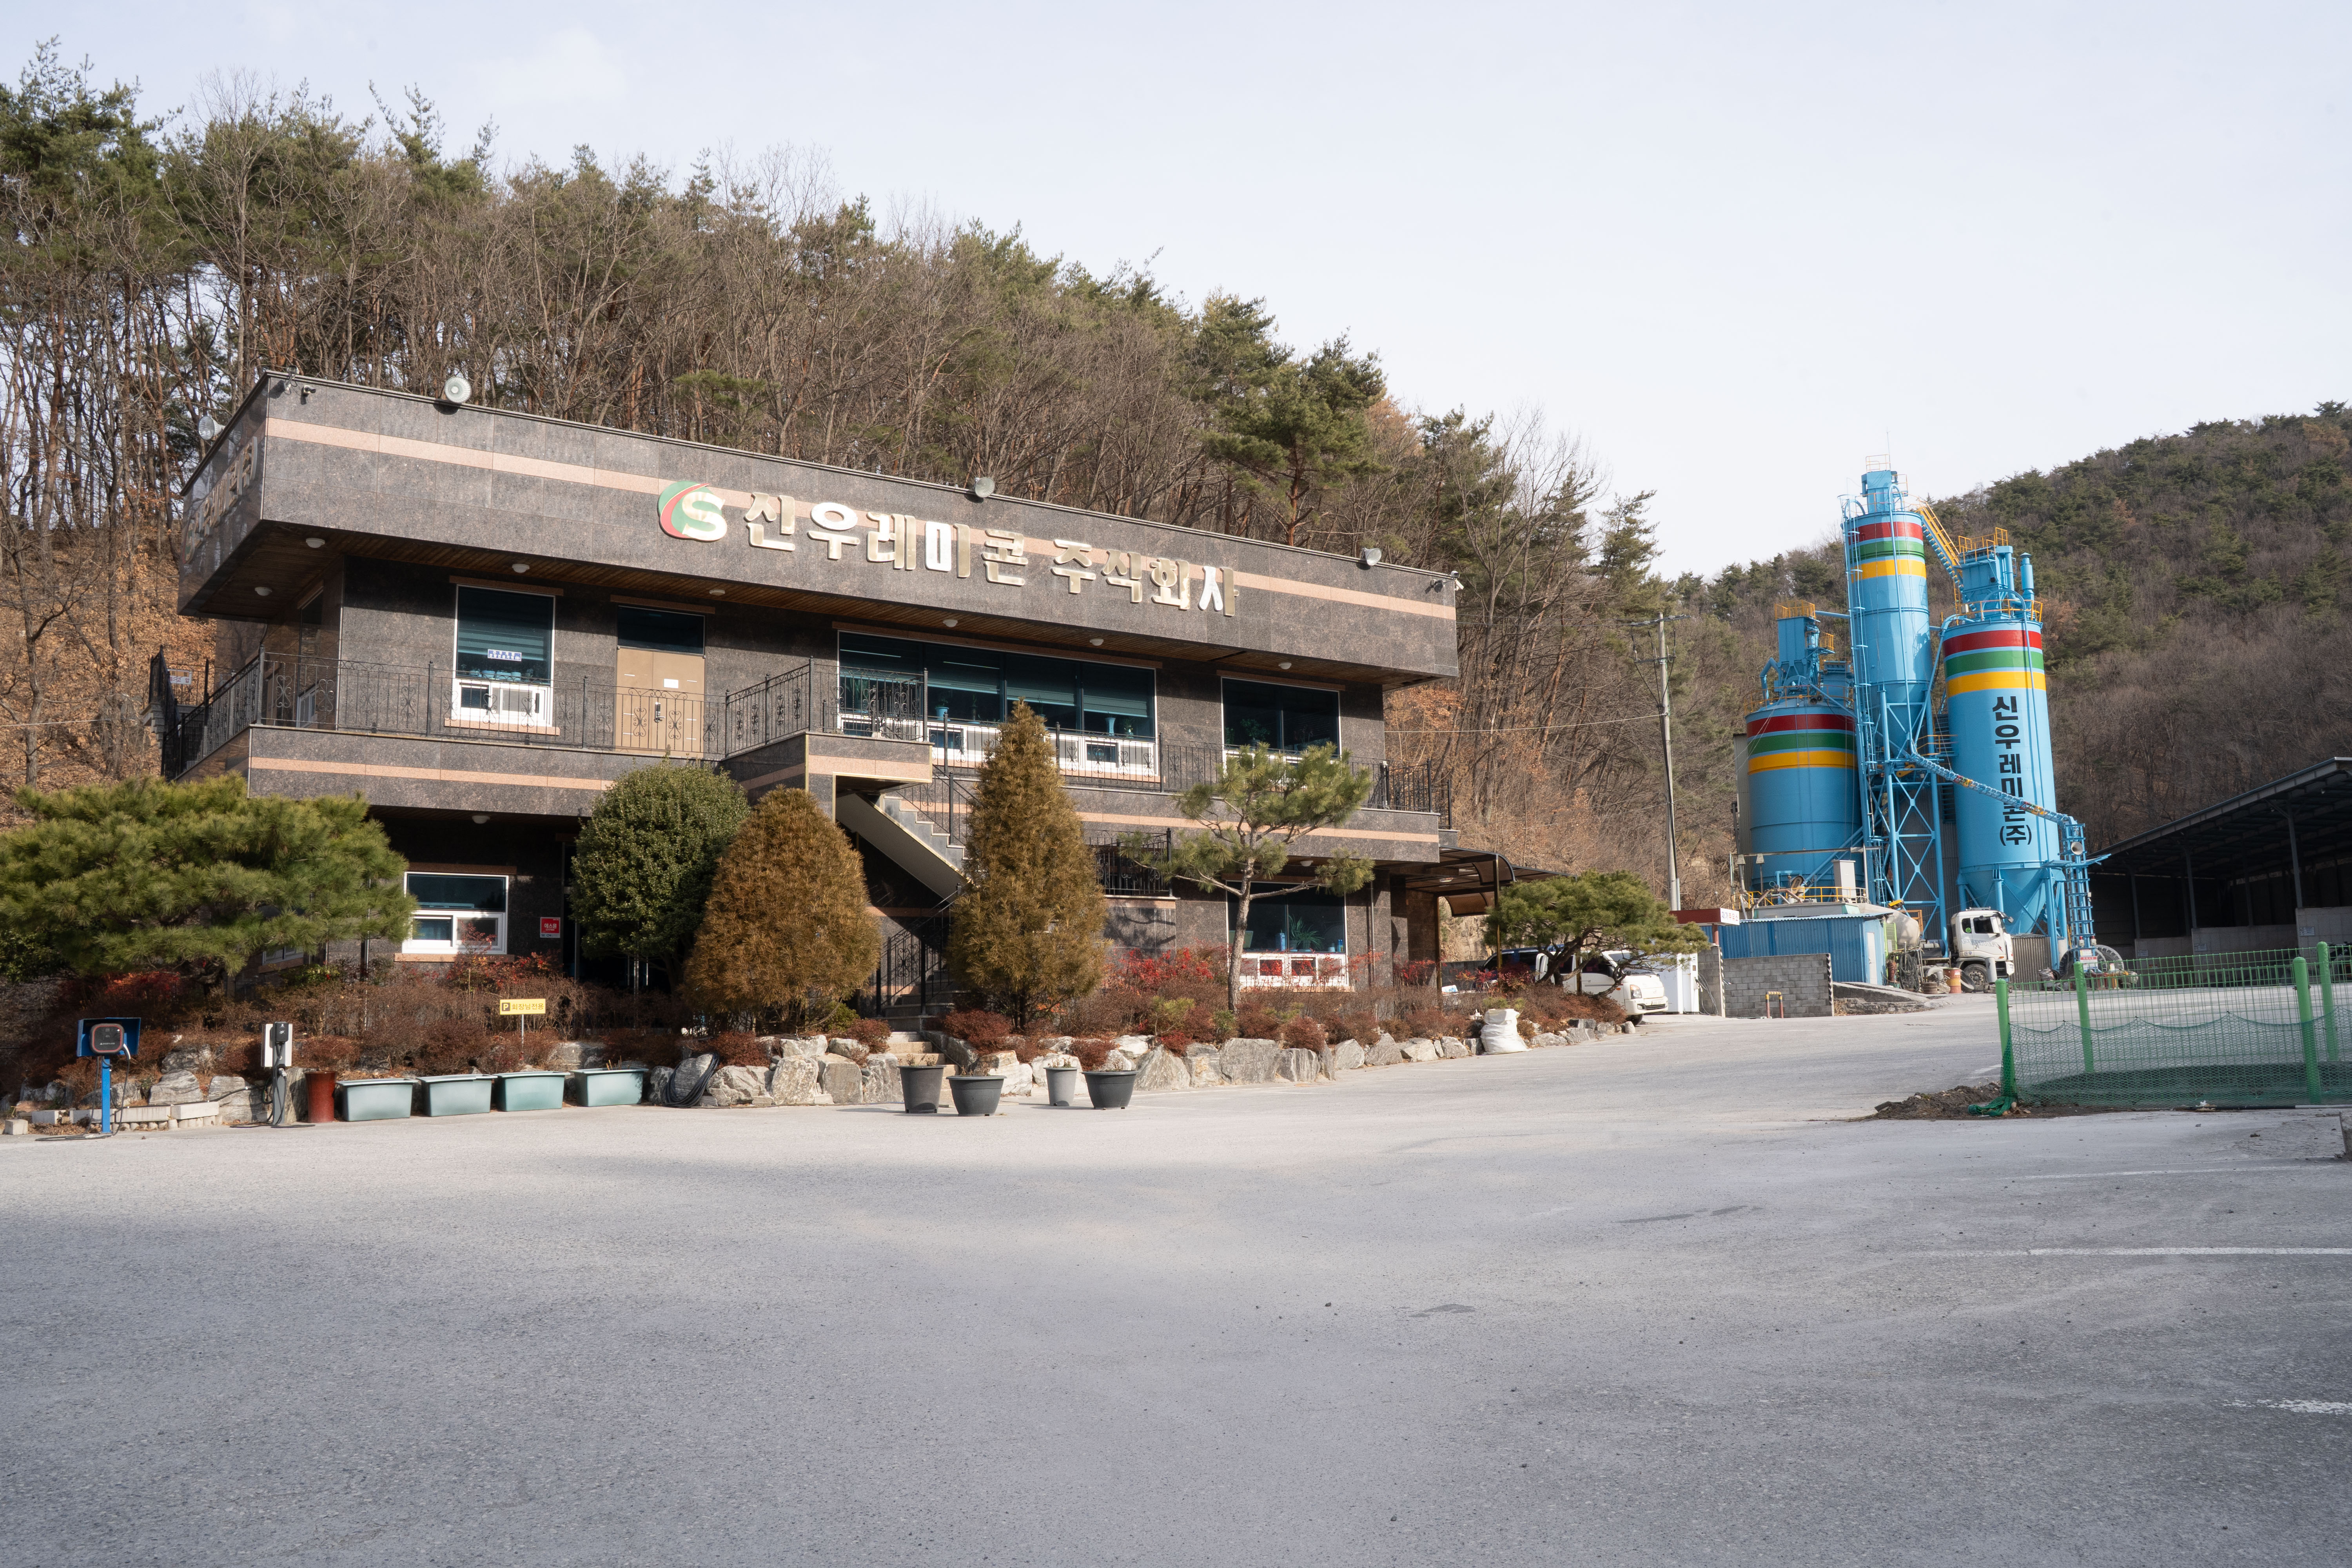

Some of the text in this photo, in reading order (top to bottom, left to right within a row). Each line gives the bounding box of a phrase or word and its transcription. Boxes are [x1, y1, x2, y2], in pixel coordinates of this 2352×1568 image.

[682, 491, 728, 542] S
[744, 492, 1240, 617] 신우레미콘 주식회사
[1992, 696, 2032, 846] 신우레미콘(주)
